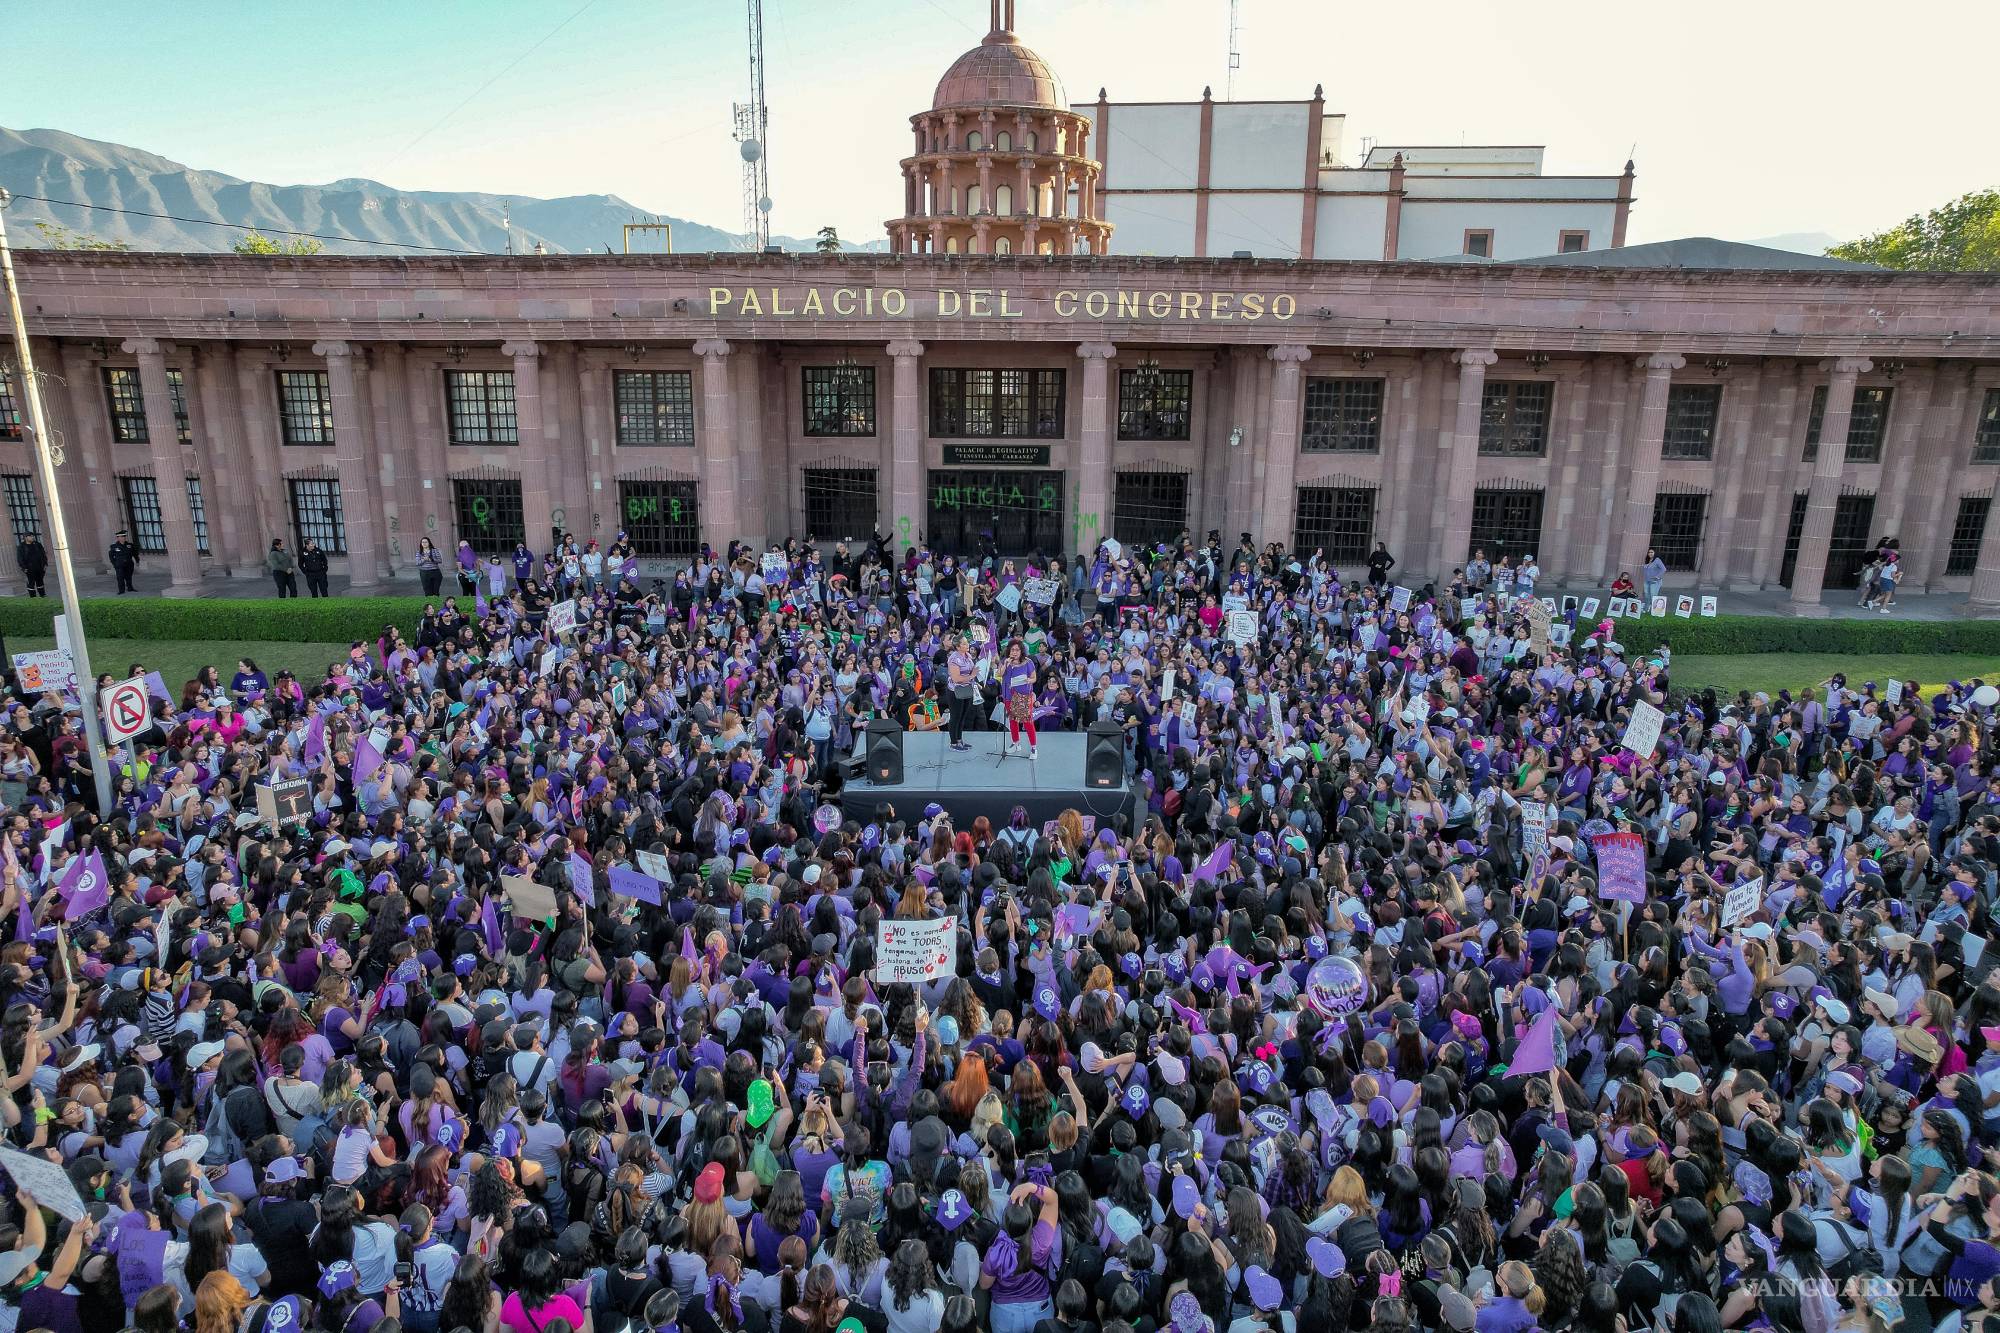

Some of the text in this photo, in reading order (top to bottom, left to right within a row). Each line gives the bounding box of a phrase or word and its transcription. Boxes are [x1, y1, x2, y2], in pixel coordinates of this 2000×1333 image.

[708, 287, 1296, 321] PALACIO DEL CONGRESO
[892, 927, 906, 937] NO
[913, 936, 942, 947] TODAS
[884, 947, 917, 957] tengamos
[893, 965, 924, 975] ABUSO
